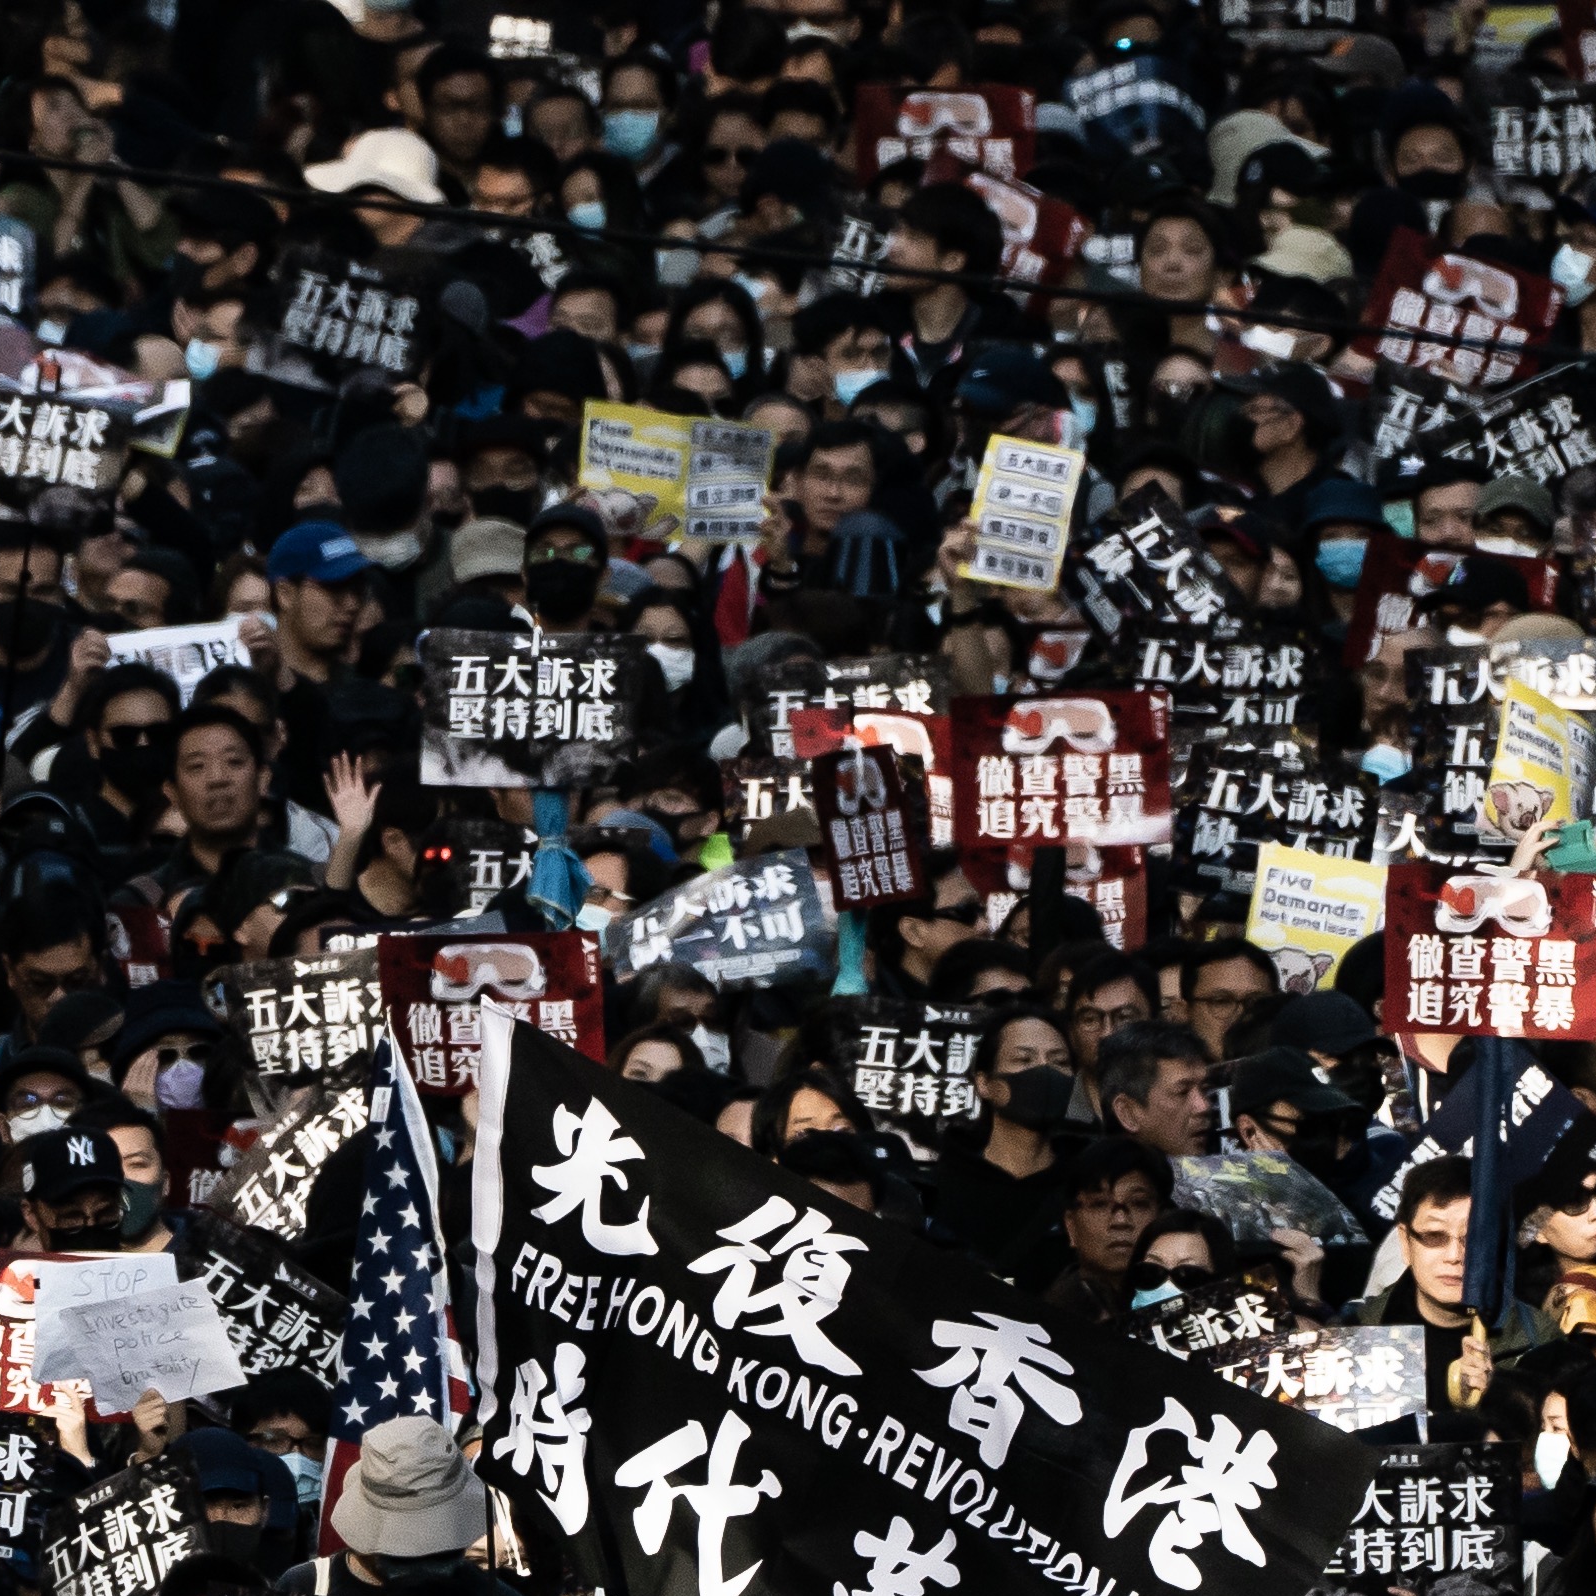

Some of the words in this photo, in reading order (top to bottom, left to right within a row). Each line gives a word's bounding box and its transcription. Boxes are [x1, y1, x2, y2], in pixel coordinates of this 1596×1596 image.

[450, 656, 616, 698] 五大訴求
[1138, 640, 1303, 690] 五大訴求
[450, 700, 615, 740] 堅持到底
[978, 755, 1145, 797] 徹查警黑
[1203, 768, 1365, 830] 五大訴求
[1267, 867, 1314, 892] Five
[1406, 935, 1578, 985] 徹查警黑
[1406, 982, 1576, 1033] 追究警暴
[71, 1268, 150, 1298] STOP
[511, 1242, 598, 1332] FREE
[603, 1275, 721, 1375] HONG
[531, 1096, 1278, 1590] 光復香港
[48, 1485, 188, 1585] 五大訴求
